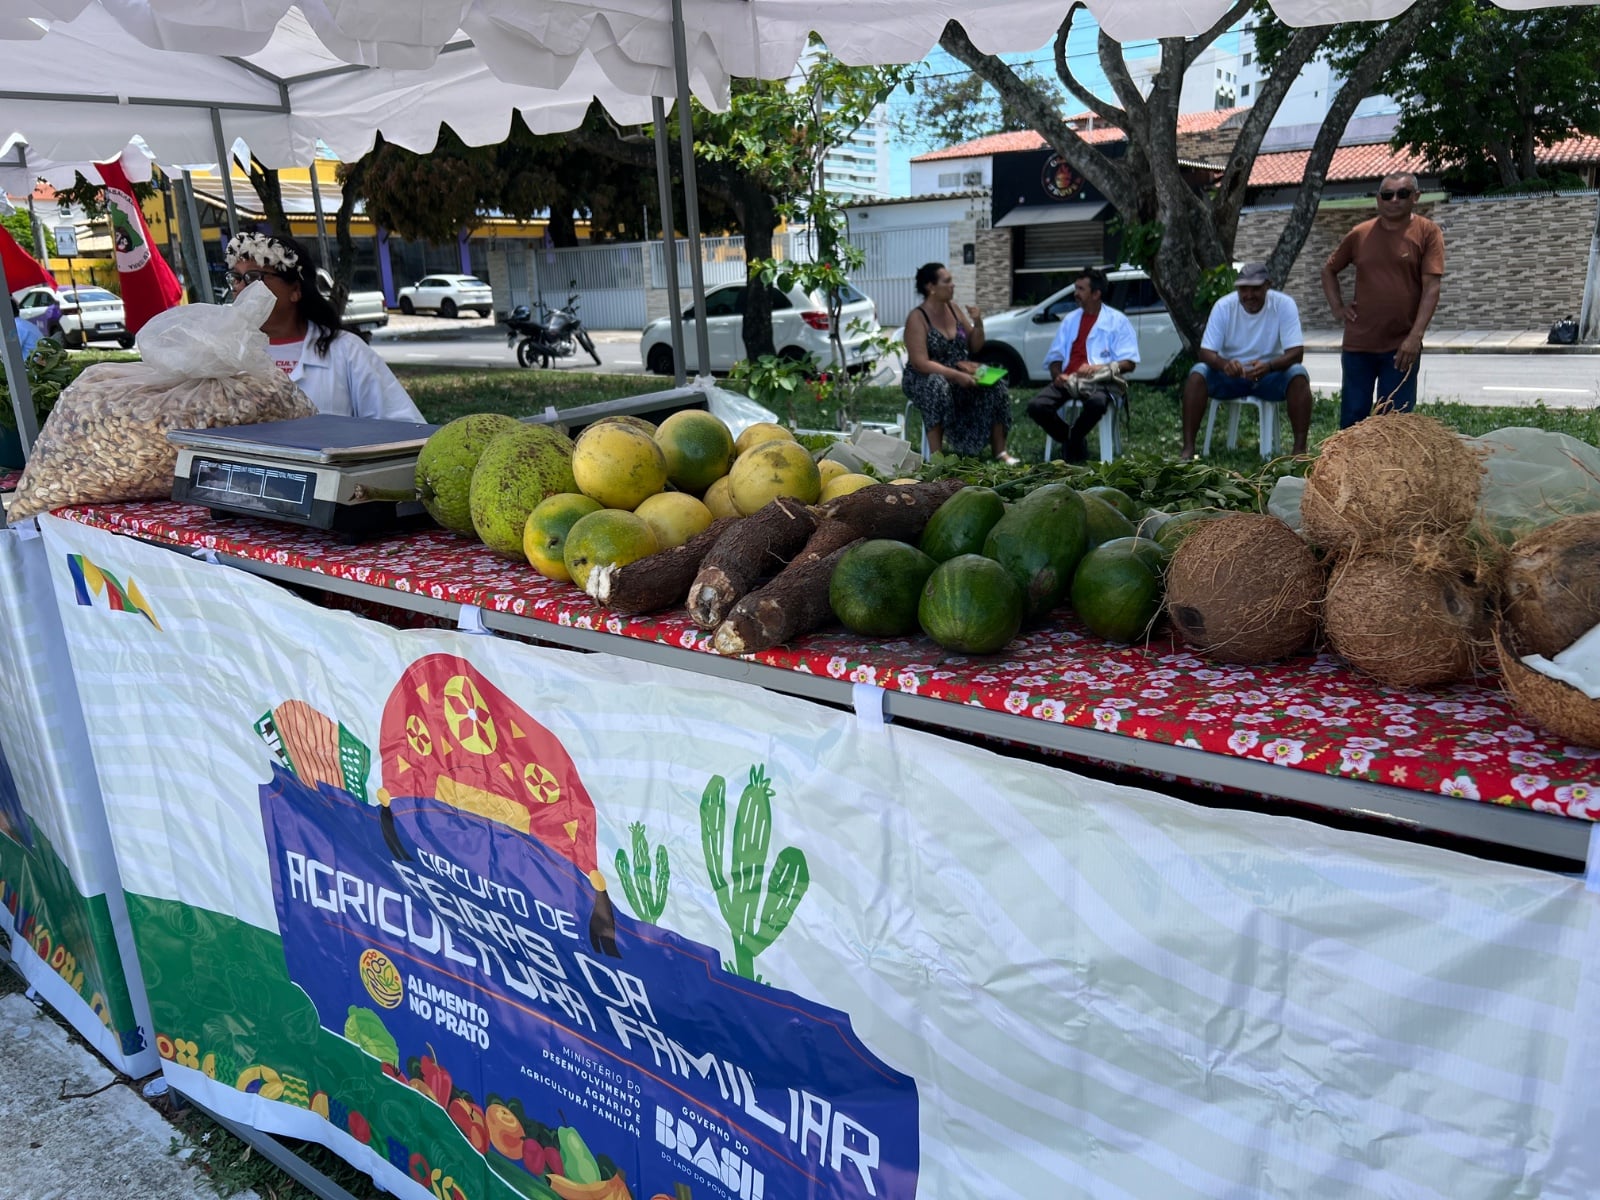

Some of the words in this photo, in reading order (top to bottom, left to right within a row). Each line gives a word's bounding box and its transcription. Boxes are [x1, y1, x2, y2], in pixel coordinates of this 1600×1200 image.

[417, 847, 529, 920] CIRCUITO
[534, 899, 580, 940] DE
[391, 859, 567, 980] FEIRAS
[573, 951, 657, 1024] DA
[286, 850, 597, 1033] AGRICULTURA
[607, 1006, 881, 1197] FAMILIAR
[407, 973, 490, 1029] ALIMENTO
[408, 1000, 432, 1021] NO
[434, 1006, 490, 1051] PRATO
[542, 1049, 641, 1109] DESENVOLVIMENTO
[562, 1046, 623, 1084] MINISTÉRIO
[627, 1079, 641, 1095] DO
[520, 1065, 589, 1109] AGRICULTURA
[592, 1104, 641, 1138] FAMILIAR
[585, 1086, 632, 1117] AGRÁRIO
[635, 1113, 641, 1124] E
[655, 1104, 765, 1200] BRASIL
[681, 1106, 730, 1142] GOVERNO
[735, 1141, 749, 1156] DO
[661, 1151, 672, 1162] DO
[673, 1159, 692, 1176] LADO
[694, 1172, 705, 1184] DO
[707, 1180, 726, 1198] POVO
